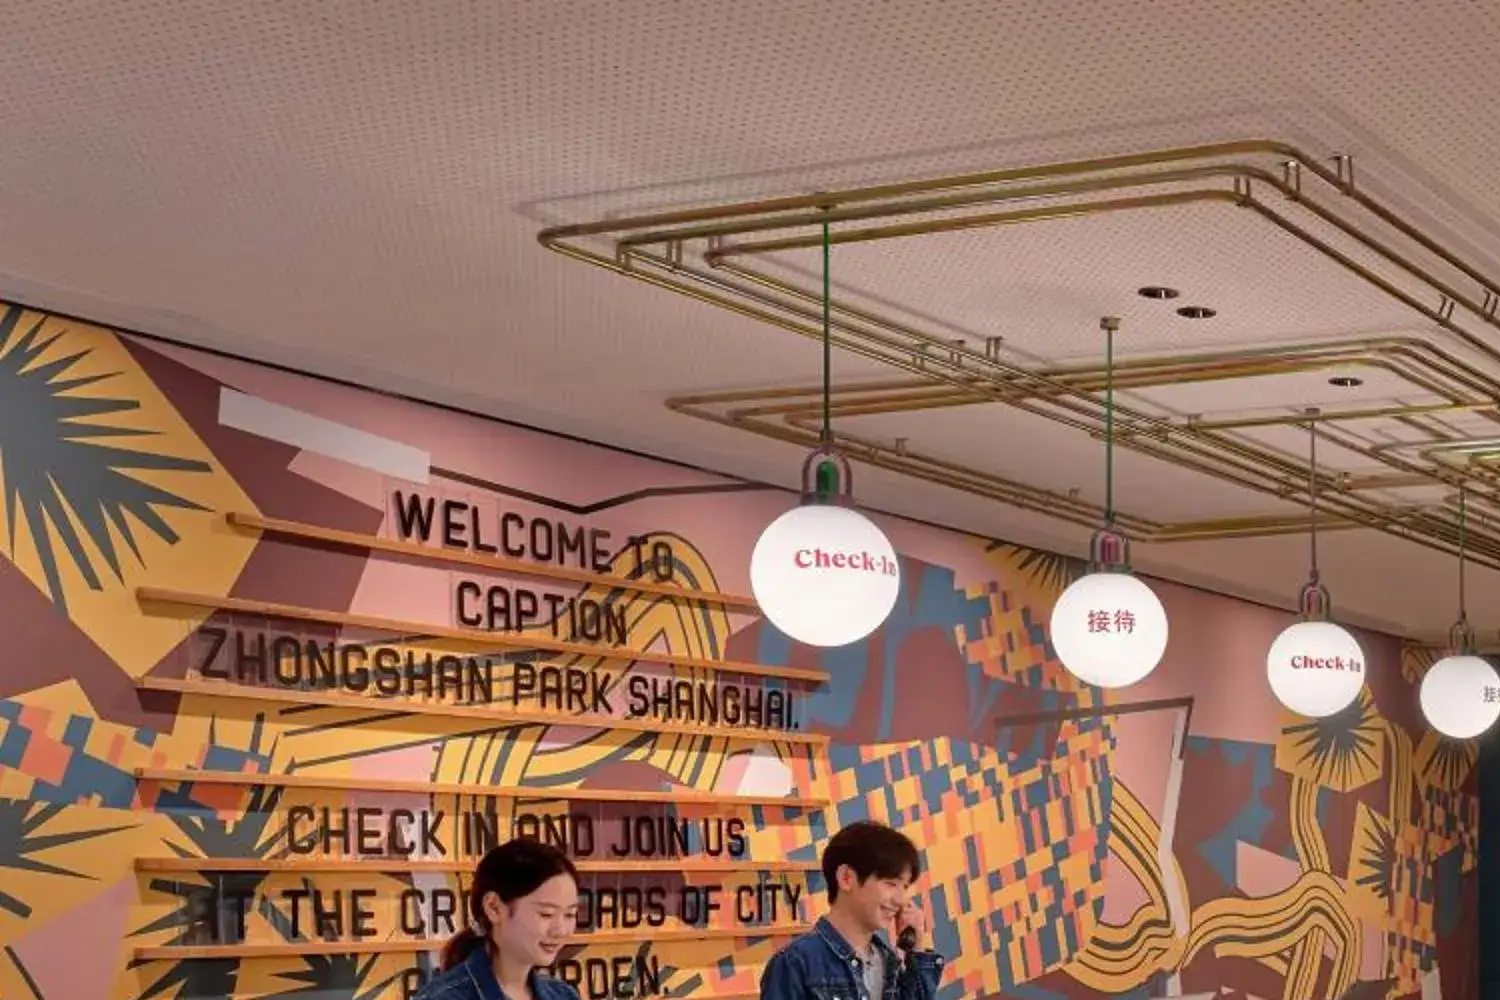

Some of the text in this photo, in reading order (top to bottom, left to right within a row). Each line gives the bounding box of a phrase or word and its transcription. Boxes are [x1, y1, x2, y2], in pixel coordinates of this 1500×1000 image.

[395, 489, 674, 582] WELCOME TO
[456, 581, 628, 646] CAPTION
[1087, 608, 1136, 634] 接待
[200, 626, 800, 729] ZHONGSHAN PARK SHANGHAI.
[286, 805, 746, 858] CHECK IN AND JOIN US
[282, 888, 378, 938] THE
[681, 884, 723, 928] OF
[737, 883, 802, 924] CITY
